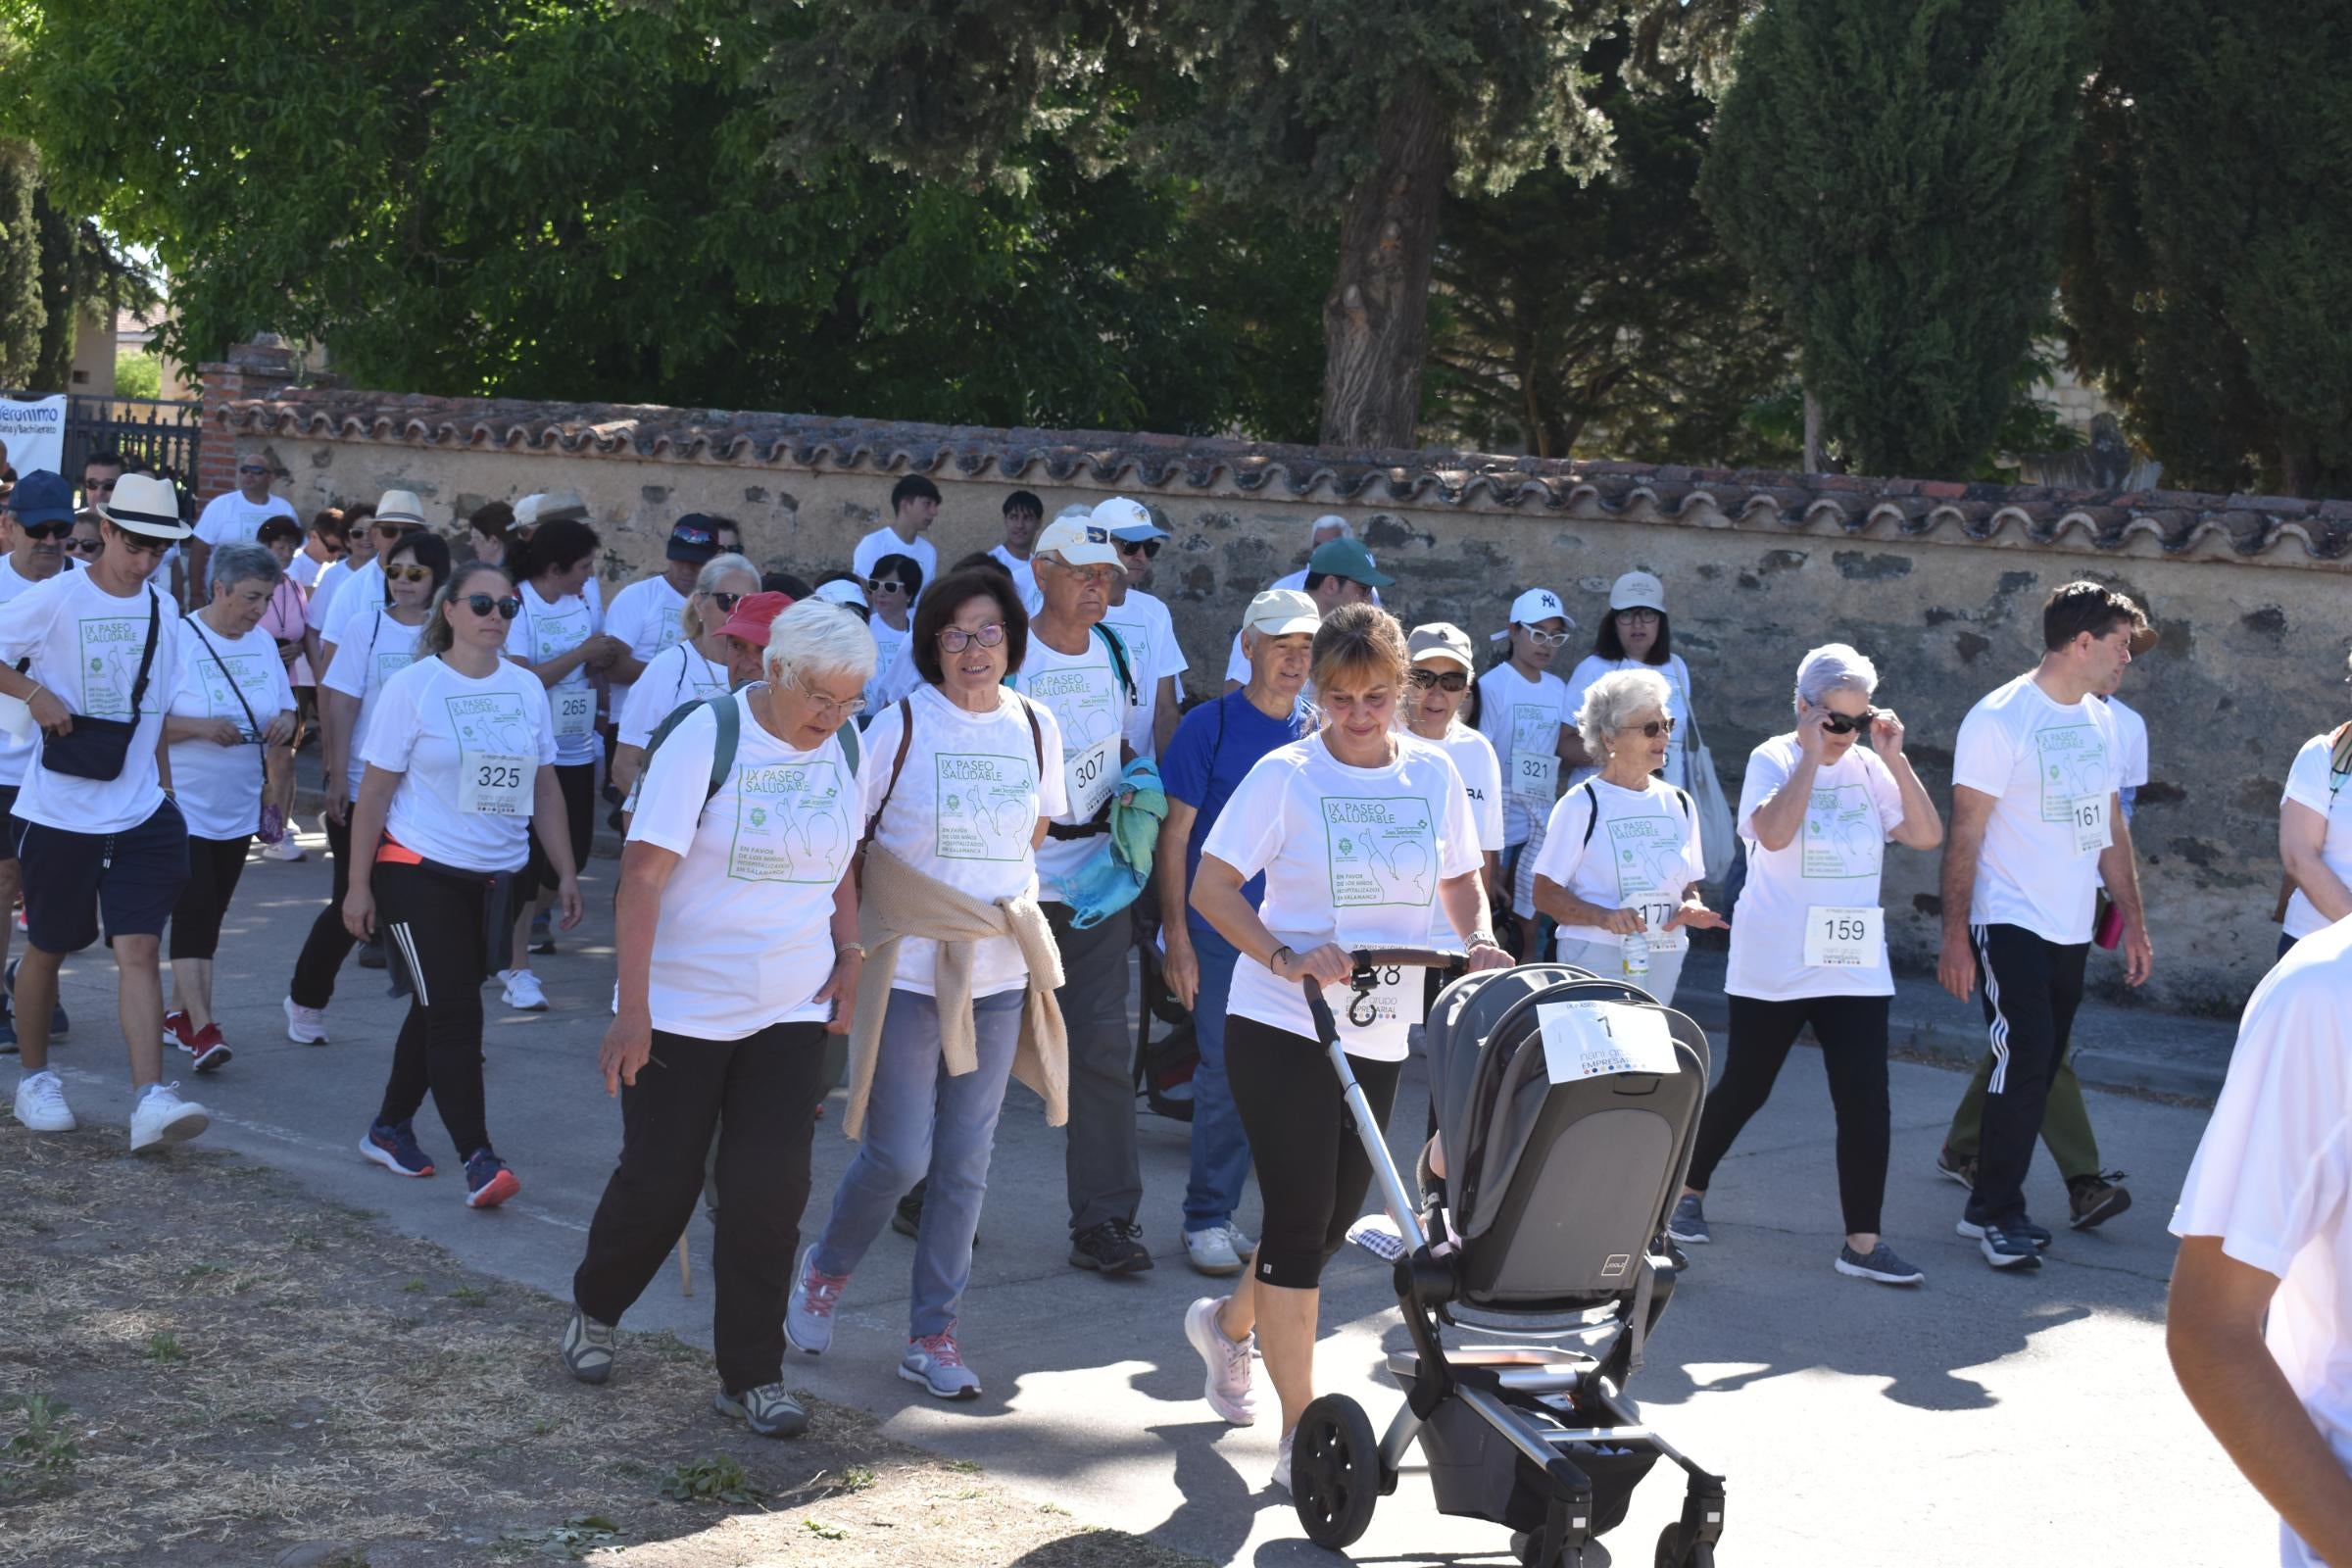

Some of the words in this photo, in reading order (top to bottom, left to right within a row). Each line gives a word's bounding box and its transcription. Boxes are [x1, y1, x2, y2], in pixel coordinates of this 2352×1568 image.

[99, 622, 131, 634] PASEO
[1036, 677, 1045, 687] IX
[1048, 673, 1084, 685] PASEO
[1036, 683, 1091, 697] SALUDABLE
[563, 699, 587, 715] 265
[942, 760, 952, 769] IX
[956, 760, 995, 771] PASEO
[1076, 751, 1104, 789] 307
[1522, 760, 1548, 778] 321
[478, 765, 520, 789] 325
[746, 769, 759, 781] IX
[763, 770, 805, 783] PASEO
[943, 770, 1003, 781] SALUDABLE
[1328, 804, 1340, 813] IX
[1345, 804, 1386, 814] PASEO
[2074, 804, 2100, 827] 161
[1330, 813, 1396, 824] SALUDABLE
[1624, 821, 1652, 830] PASEO
[1640, 904, 1672, 924] 177
[1825, 919, 1865, 941] 159
[1369, 996, 1397, 1006] grupo
[1597, 1015, 1612, 1038] 1
[1580, 1050, 1605, 1060] nani
